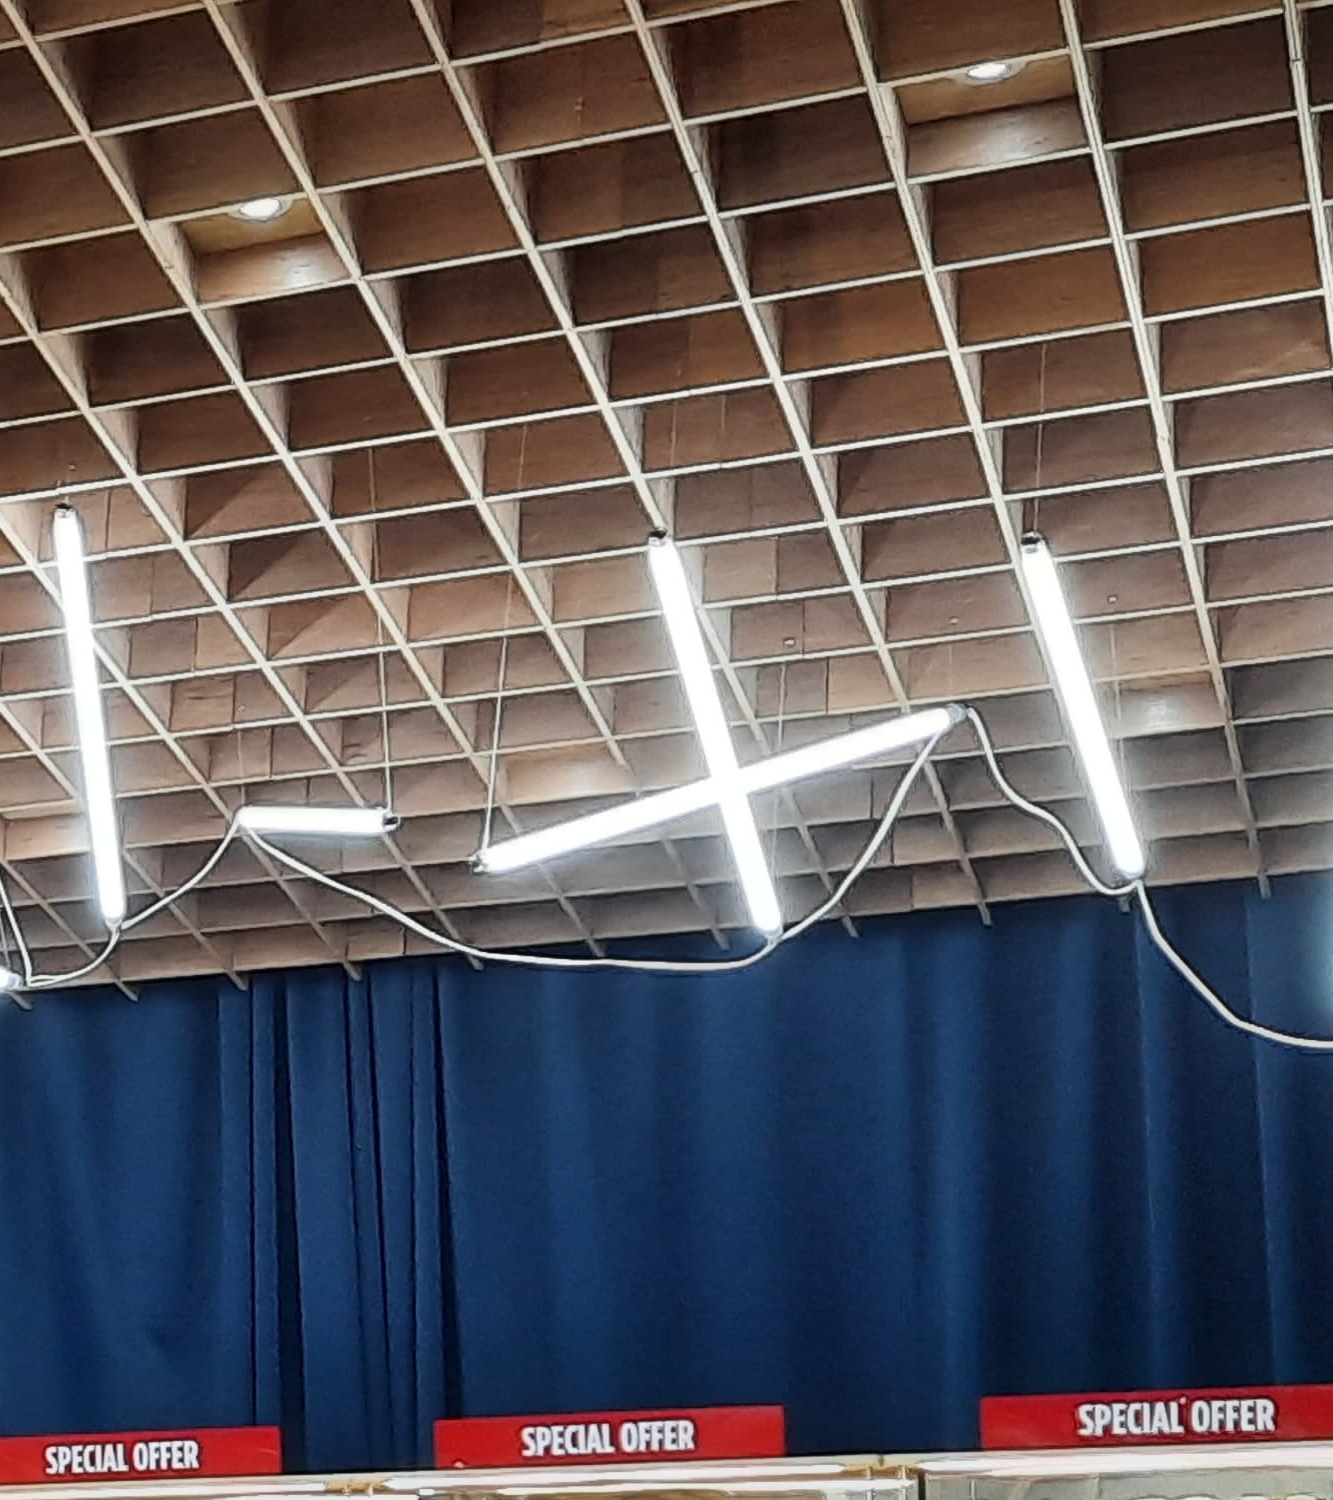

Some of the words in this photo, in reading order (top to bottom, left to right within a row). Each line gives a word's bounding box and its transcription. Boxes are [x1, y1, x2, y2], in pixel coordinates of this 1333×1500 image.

[1078, 1401, 1185, 1436] SPECIAL
[1191, 1398, 1275, 1433] OFFER
[521, 1423, 615, 1457] SPECIAL
[620, 1420, 695, 1453] OFFER
[45, 1443, 129, 1475] SPECIAL
[132, 1440, 199, 1471] OFFER
